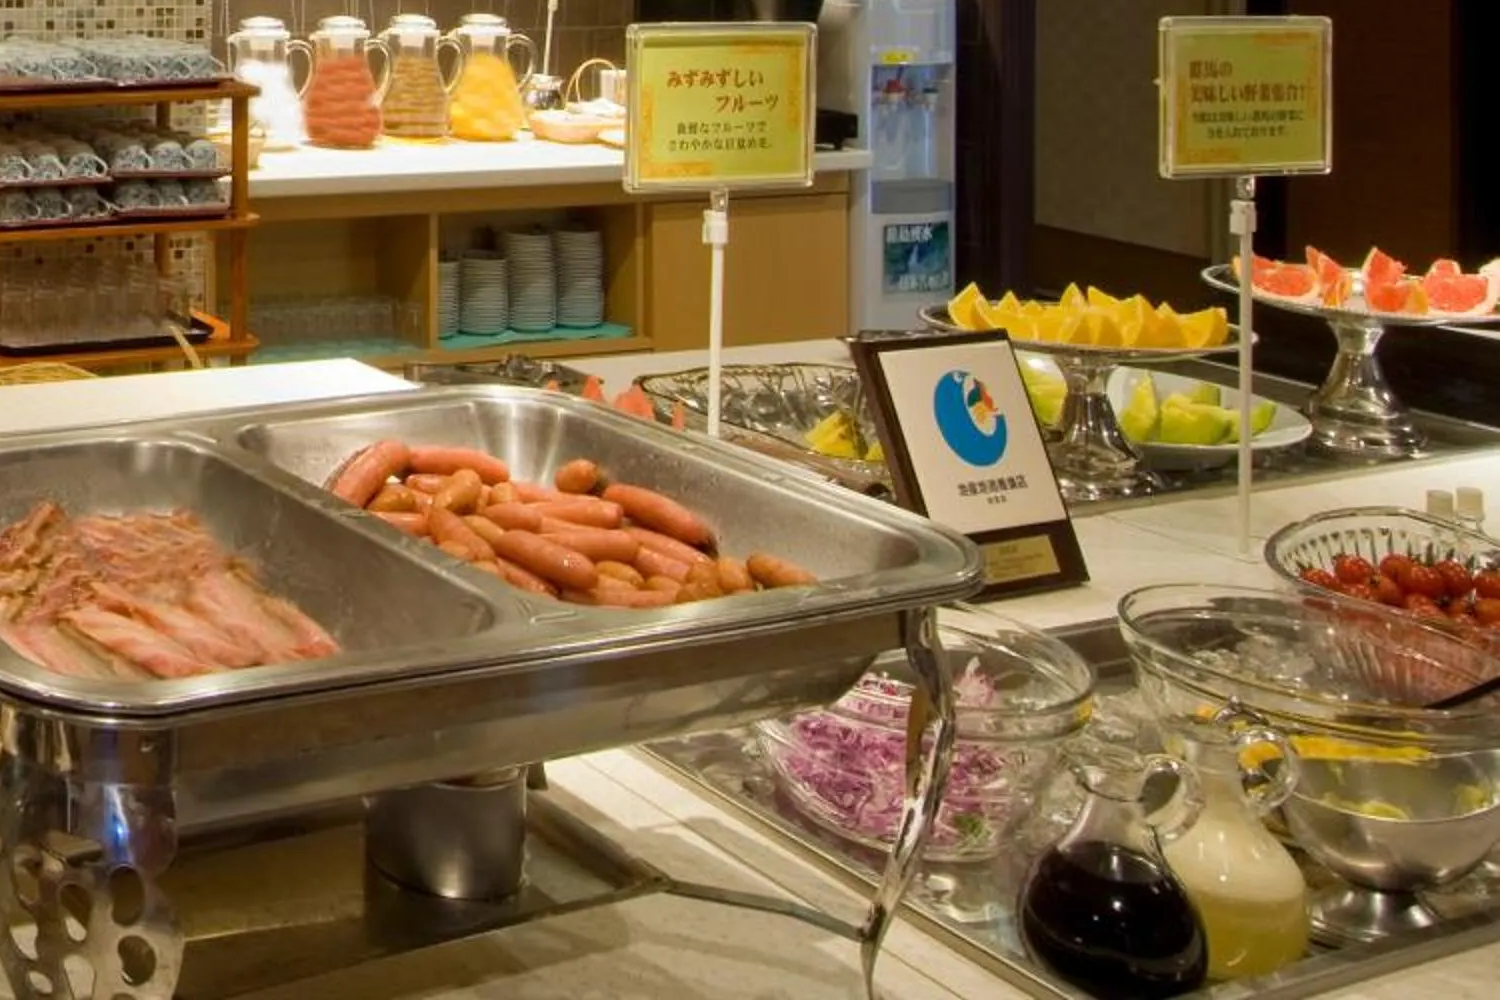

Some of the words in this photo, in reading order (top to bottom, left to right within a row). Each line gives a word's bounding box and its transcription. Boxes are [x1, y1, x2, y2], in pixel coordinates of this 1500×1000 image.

[666, 69, 763, 88] みずみずしい
[715, 94, 779, 113] フルーツ
